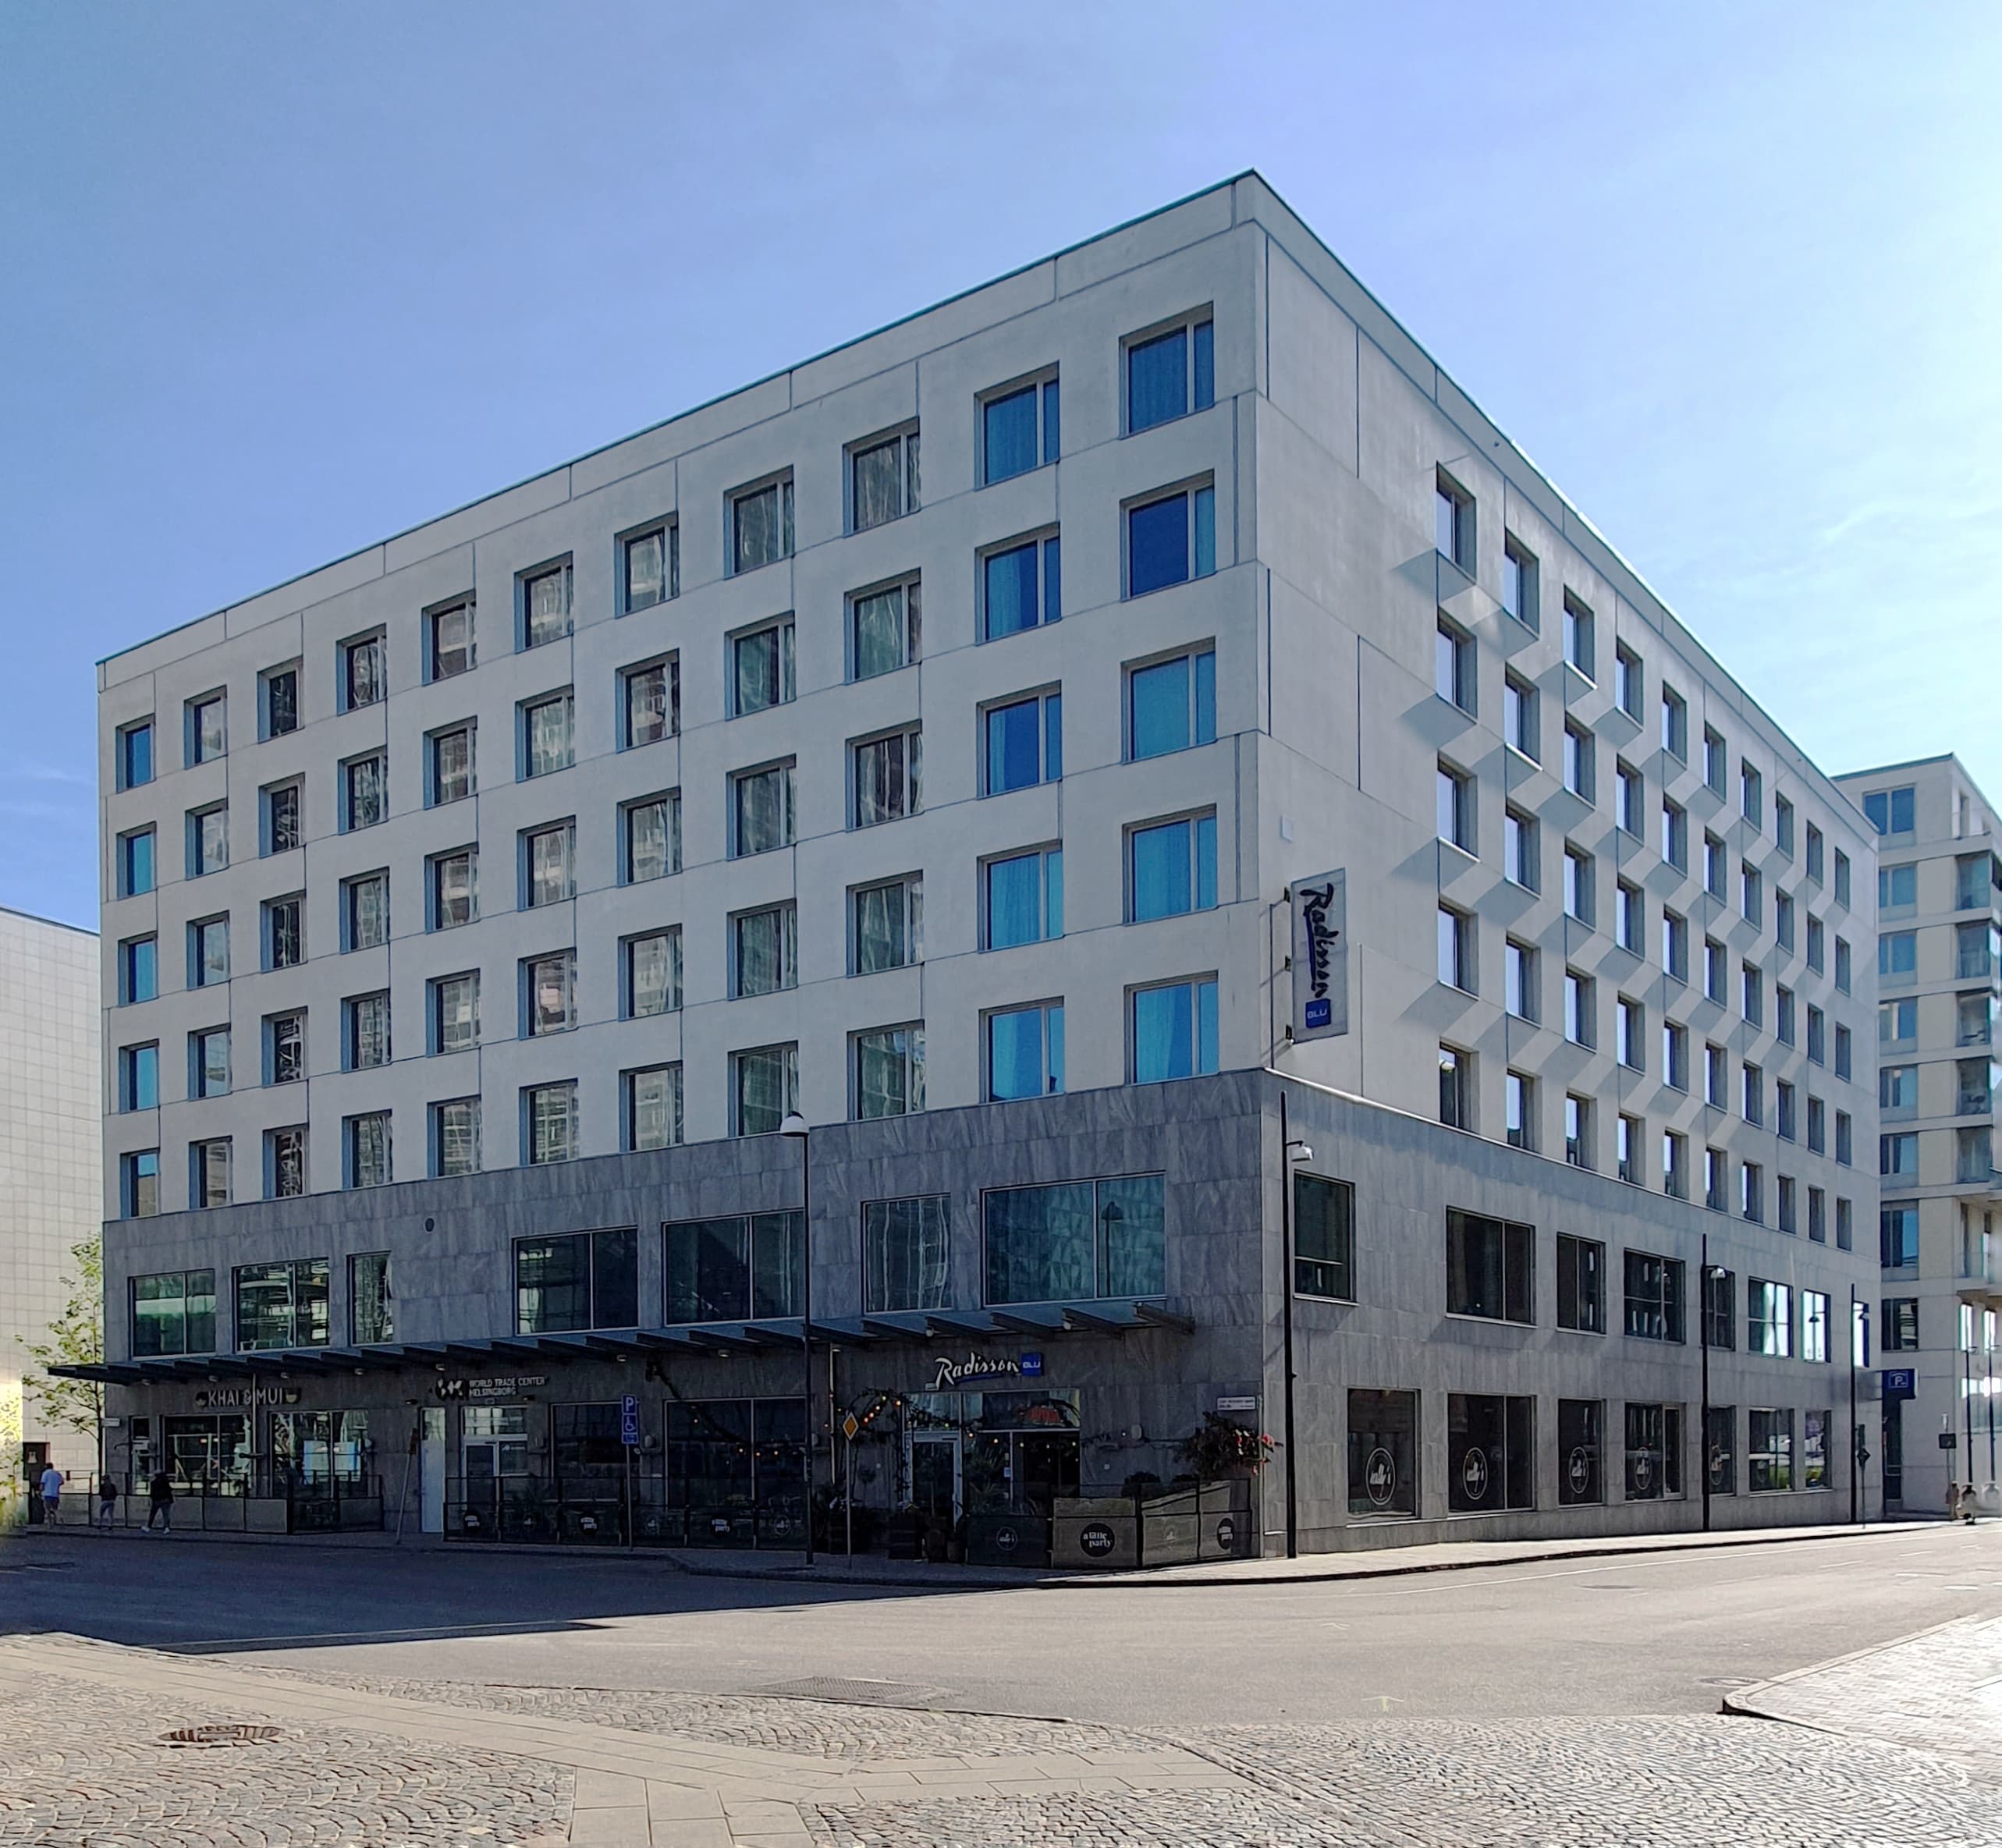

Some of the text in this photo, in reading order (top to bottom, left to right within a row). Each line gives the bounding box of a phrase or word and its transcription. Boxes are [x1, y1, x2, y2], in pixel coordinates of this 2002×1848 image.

[1299, 882, 1339, 998] Radisson
[1307, 1009, 1327, 1020] BLU
[935, 1352, 1019, 1391] Radisson
[469, 1376, 545, 1388] WORLD TRADE CENTER
[1894, 1375, 1904, 1386] P
[208, 1387, 282, 1406] KHAI & MUI
[626, 1396, 634, 1412] P
